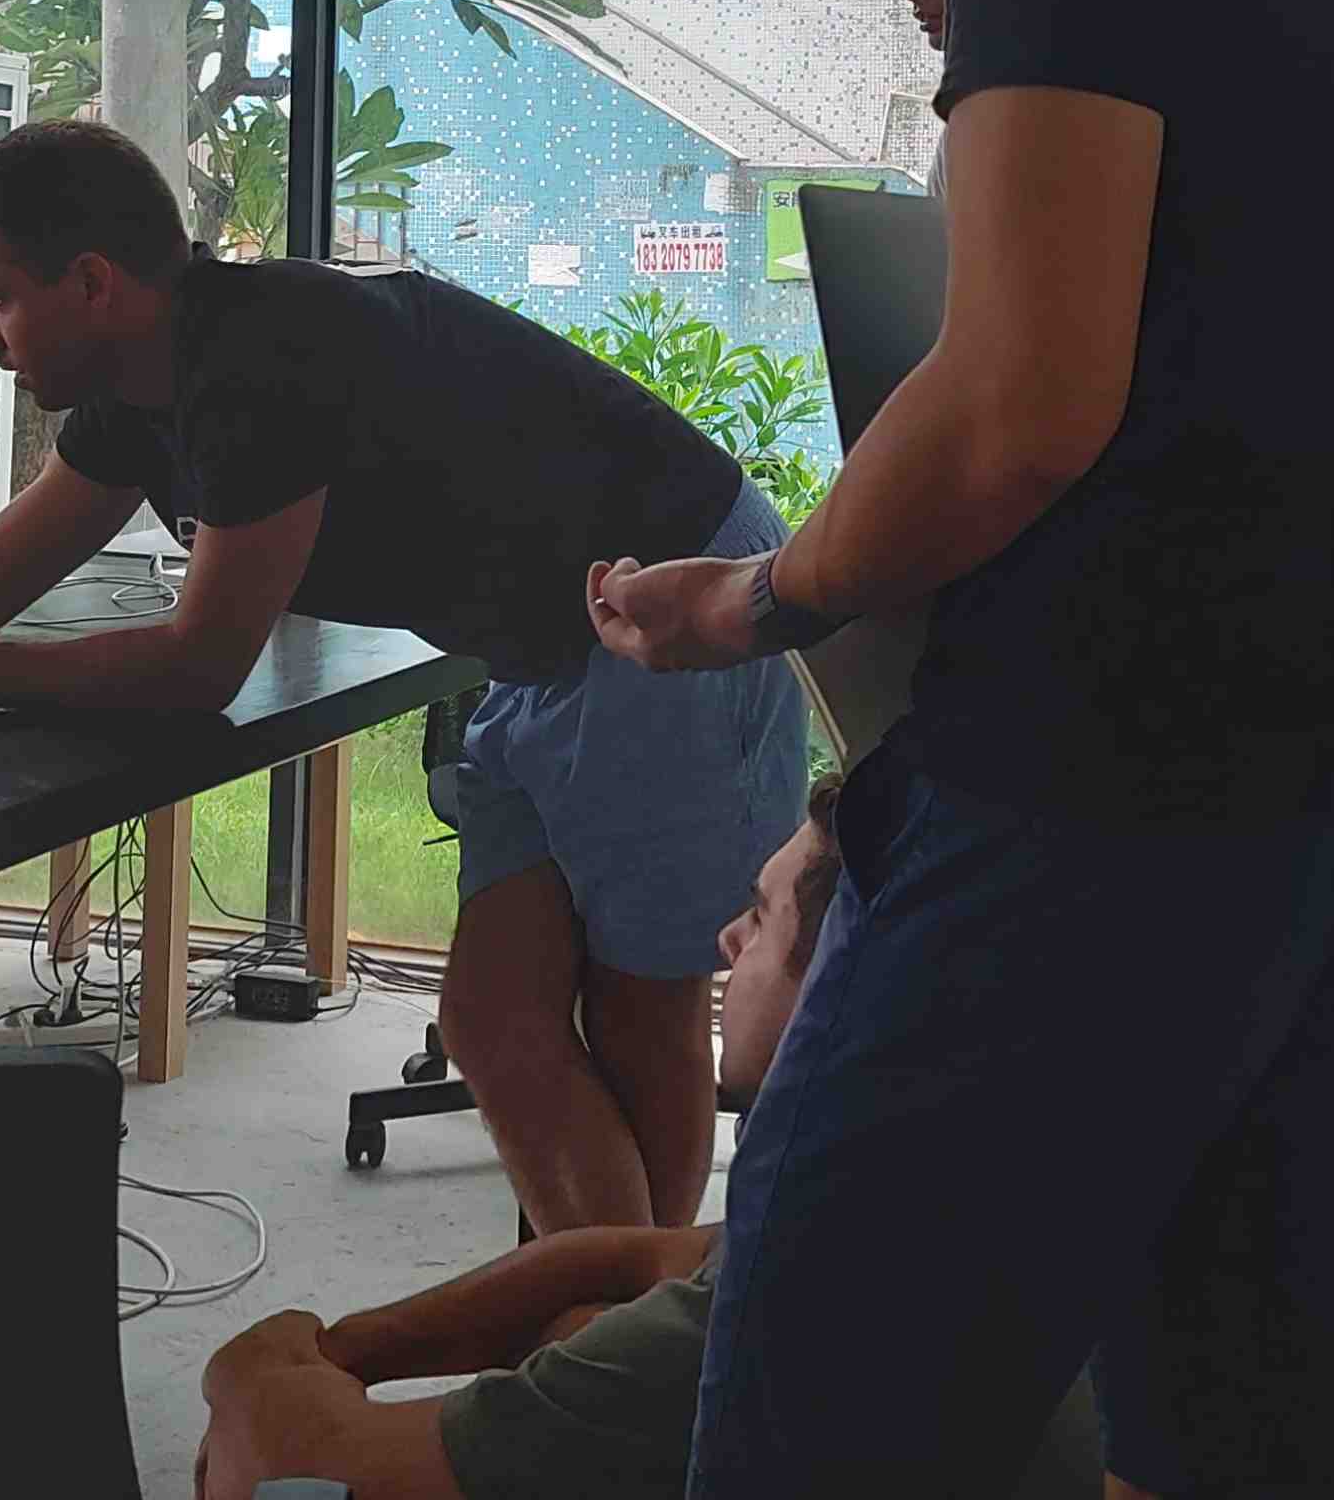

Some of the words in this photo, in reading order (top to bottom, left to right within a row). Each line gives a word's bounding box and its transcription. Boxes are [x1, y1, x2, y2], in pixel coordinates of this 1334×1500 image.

[658, 225, 702, 239] 叉车出租
[636, 242, 658, 271] 183
[661, 242, 691, 271] 2079
[693, 241, 724, 270] 7738
